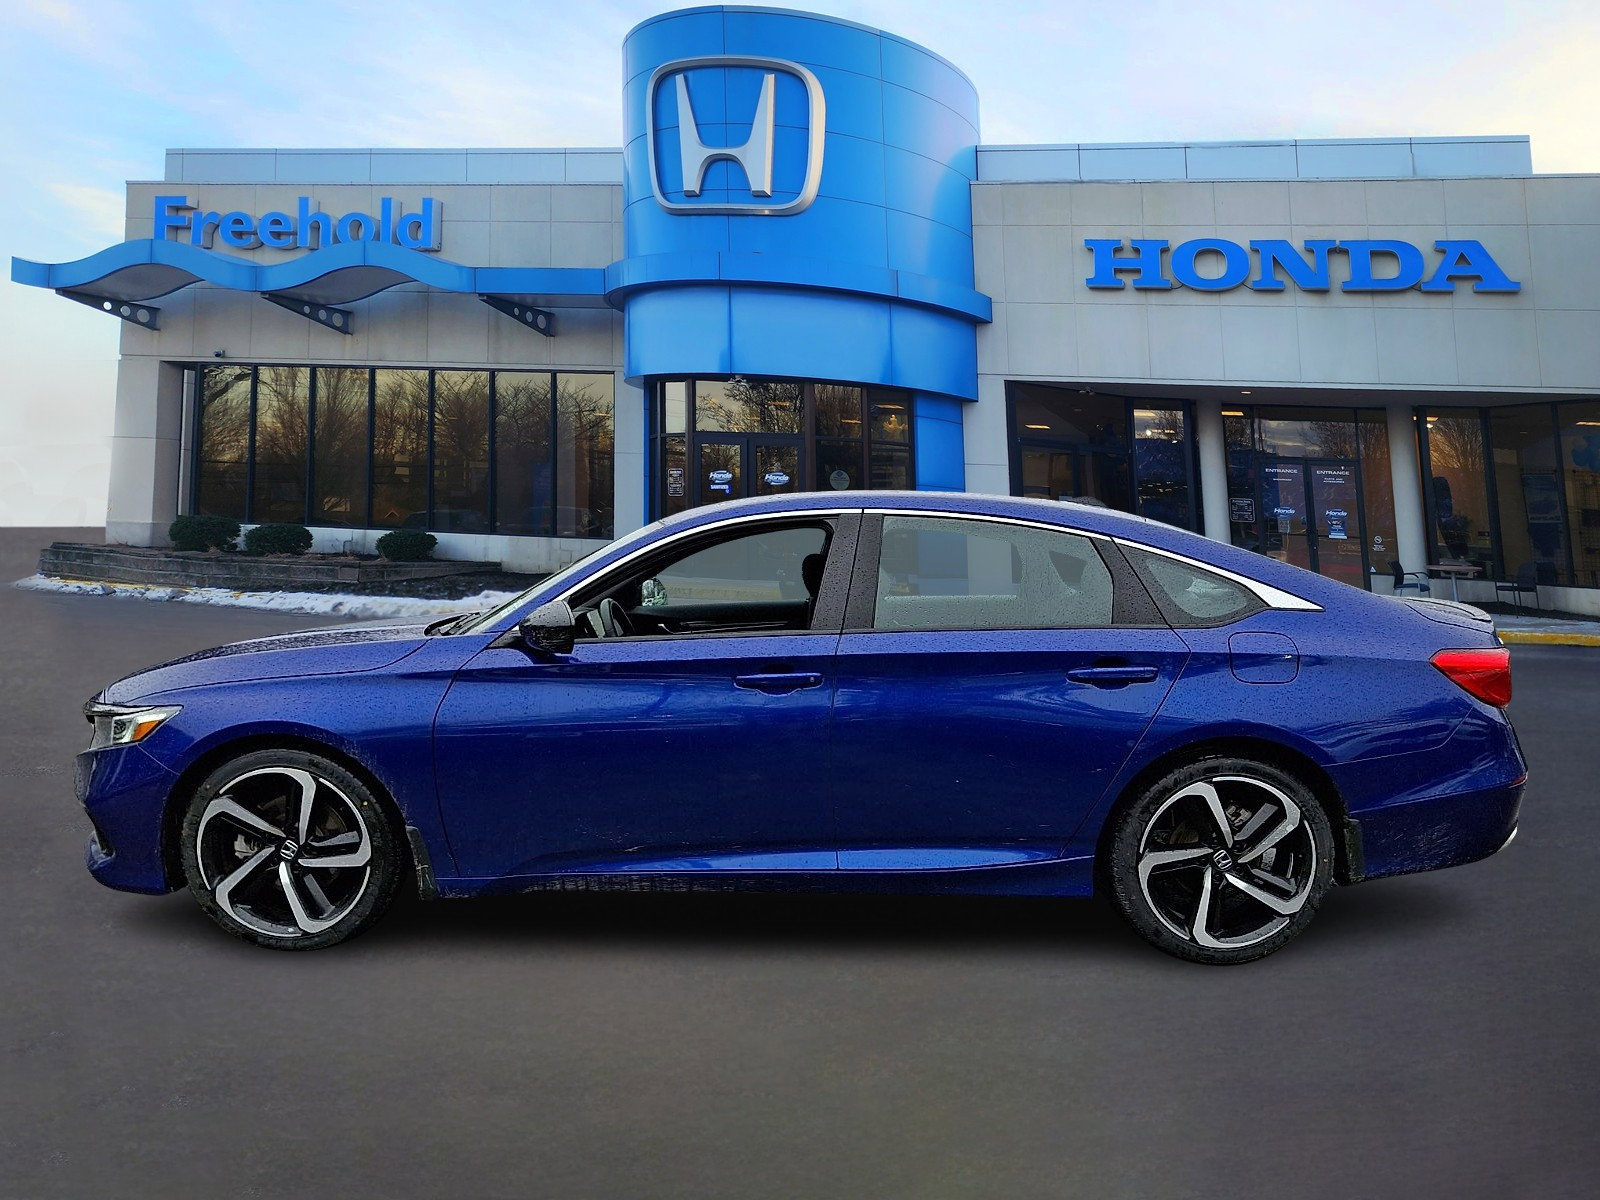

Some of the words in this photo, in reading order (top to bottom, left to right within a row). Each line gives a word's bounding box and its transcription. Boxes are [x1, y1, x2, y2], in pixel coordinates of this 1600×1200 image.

[153, 194, 436, 249] Freehold
[1084, 238, 1522, 293] HONDA
[709, 472, 732, 480] Honda
